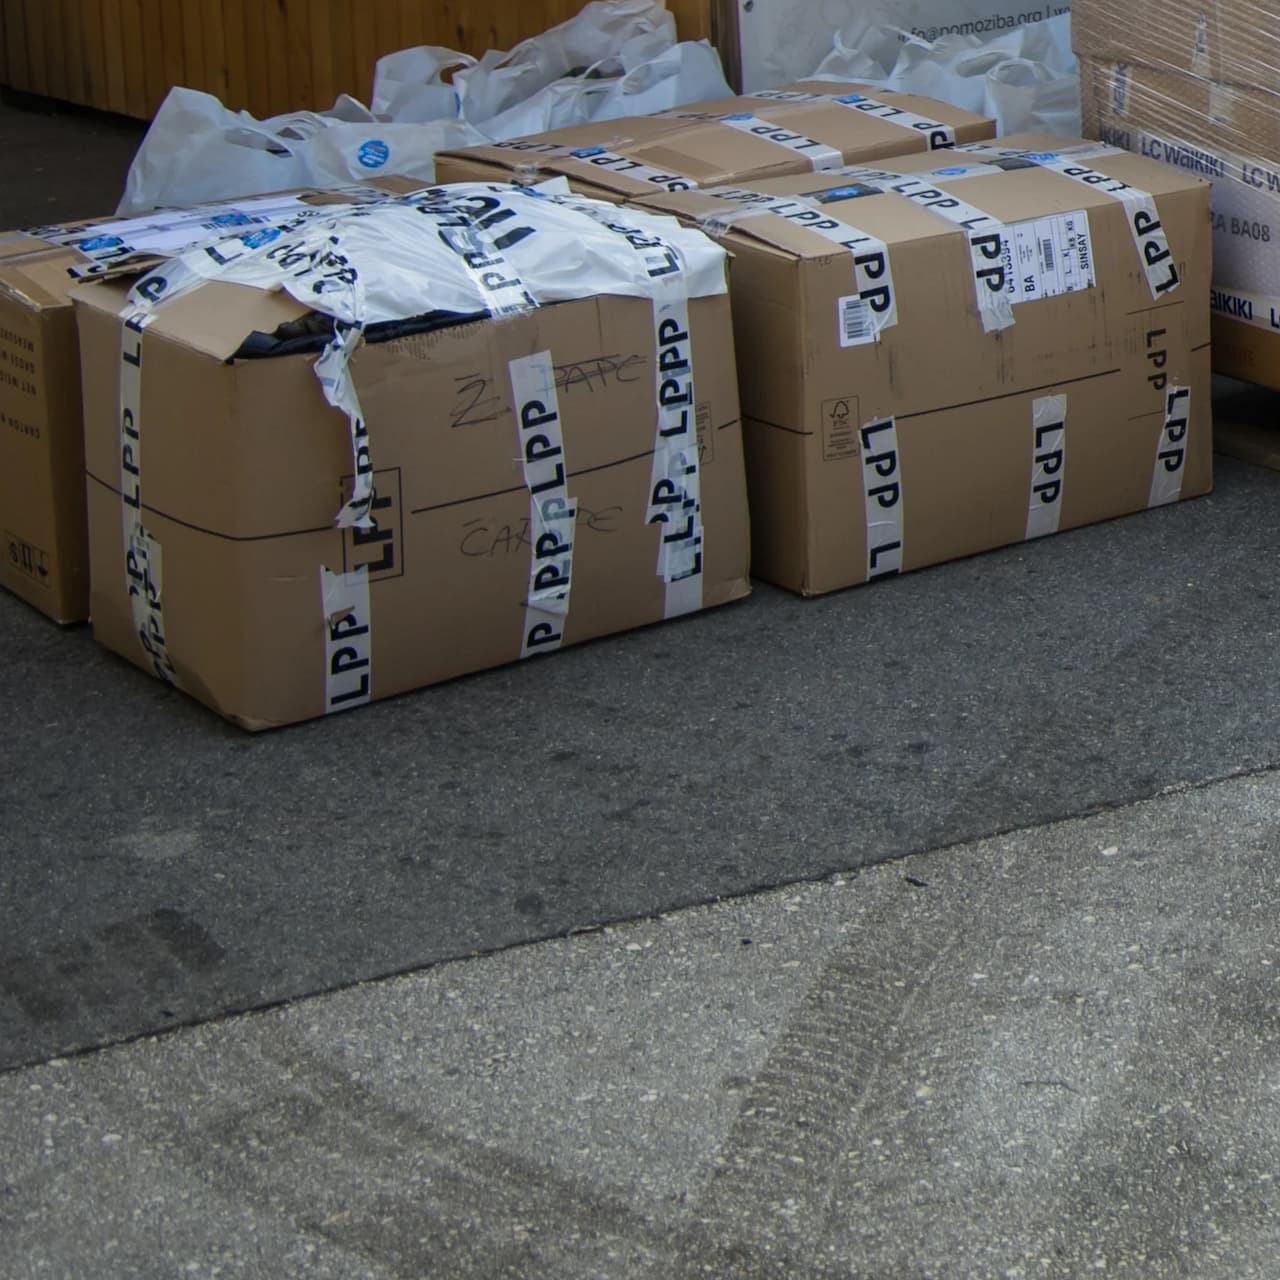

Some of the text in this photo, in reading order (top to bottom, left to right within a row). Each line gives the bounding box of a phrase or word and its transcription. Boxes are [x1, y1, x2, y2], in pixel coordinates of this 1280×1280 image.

[751, 125, 822, 151] LPP
[1141, 136, 1161, 161] LC
[894, 182, 959, 212] LPP
[1242, 164, 1265, 188] LC
[768, 202, 840, 230] LPP
[1231, 218, 1271, 243] BA08
[1080, 233, 1090, 270] SINSAY
[1134, 210, 1180, 294] LPP
[1024, 274, 1036, 293] BA
[1144, 328, 1167, 391] LPP
[521, 399, 565, 496] LPP
[1158, 388, 1190, 473] LPP
[122, 407, 141, 510] LPP
[858, 420, 900, 508] LPP
[1035, 421, 1065, 505] LPP
[329, 611, 370, 708] LPP
